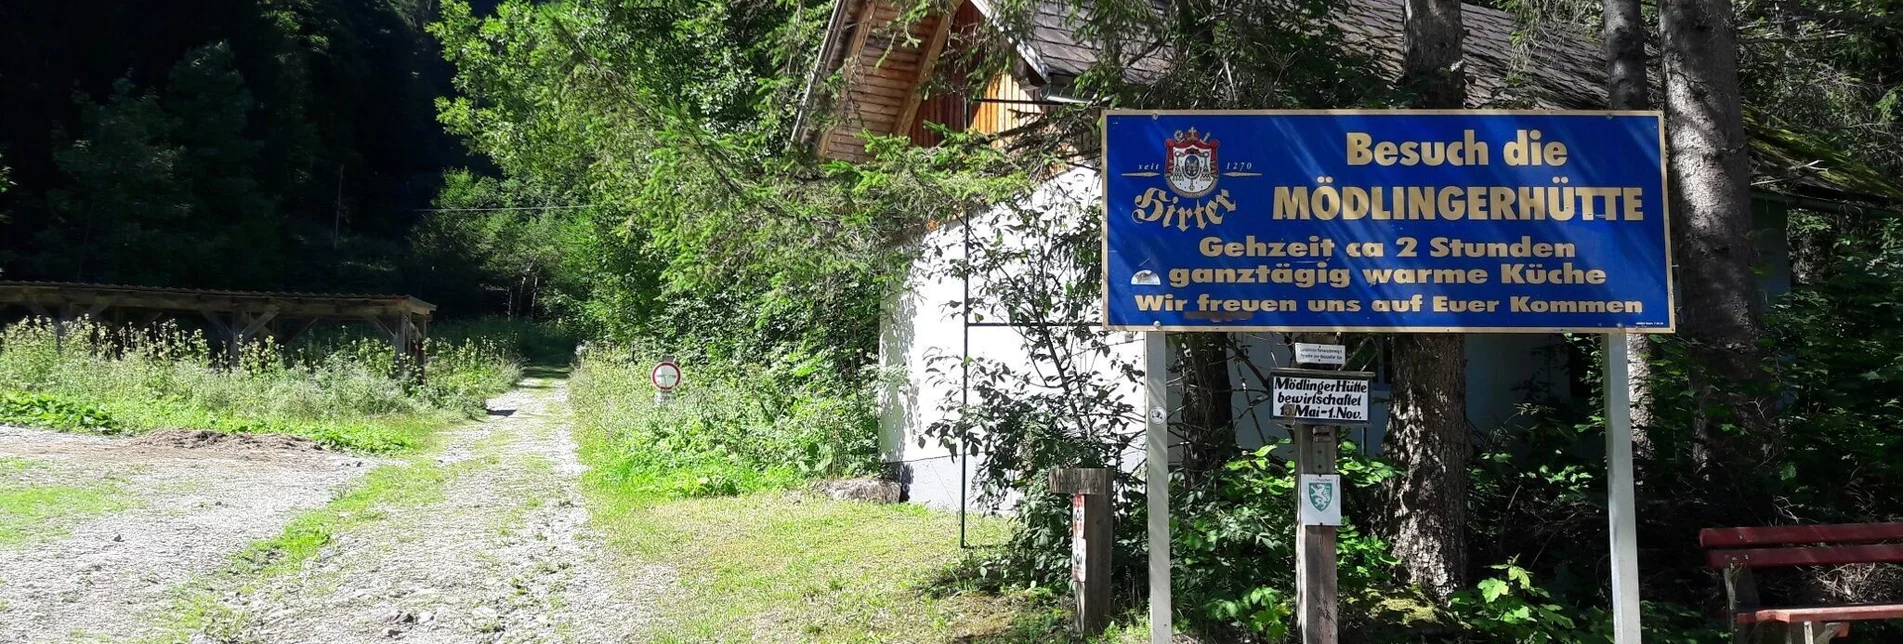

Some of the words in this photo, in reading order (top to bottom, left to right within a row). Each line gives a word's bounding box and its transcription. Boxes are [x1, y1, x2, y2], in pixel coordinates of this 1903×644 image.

[1346, 129, 1489, 167] Besuch
[1503, 129, 1568, 167] die
[1138, 163, 1160, 171] seit
[1226, 162, 1252, 170] 1270
[1131, 187, 1237, 233] Hirter
[1272, 176, 1644, 222] MÖDLINGERHÜTTE
[1199, 235, 1335, 258] Gehzeit
[1346, 242, 1384, 258] ca
[1395, 237, 1418, 258] 2
[1430, 235, 1576, 258] Stunden
[1168, 261, 1351, 289] ganztägig
[1362, 266, 1488, 286] warme
[1500, 262, 1607, 285] Küche
[1135, 294, 1188, 312] Wir
[1197, 293, 1297, 313] freuen
[1307, 299, 1361, 313] uns
[1371, 294, 1423, 313] auf
[1433, 295, 1500, 313] Euer
[1510, 295, 1643, 314] Kommen
[1277, 391, 1362, 406] bewirtschaftet
